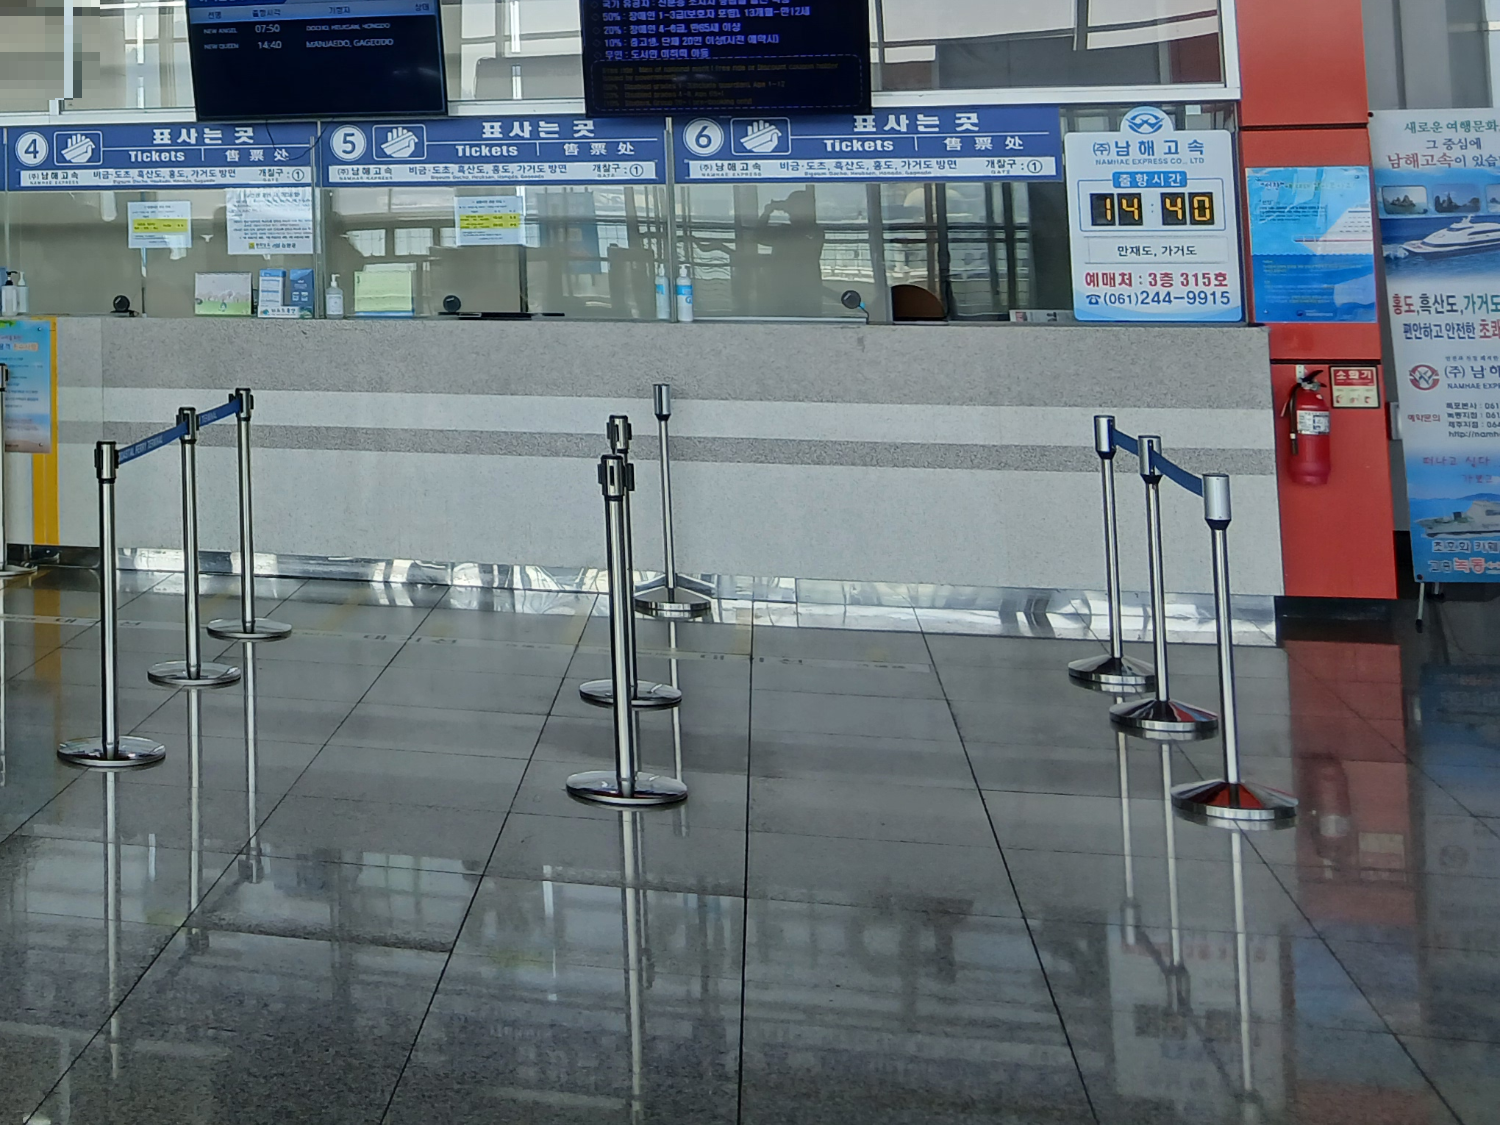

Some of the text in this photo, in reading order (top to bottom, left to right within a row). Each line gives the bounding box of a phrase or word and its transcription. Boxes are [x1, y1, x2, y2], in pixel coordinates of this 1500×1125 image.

[255, 24, 280, 33] 07:50
[258, 41, 281, 49] 14:40
[1405, 120, 1500, 133] 새로운 여행문화
[456, 144, 517, 157] Tickets
[824, 139, 893, 152] Tickets
[1426, 137, 1482, 151] 그 중심에
[129, 151, 184, 163] Tickets
[1387, 152, 1466, 169] 남해고속이
[1119, 173, 1182, 187] 출항시간
[1118, 245, 1197, 257] 만재도, 가거도
[1085, 272, 1228, 288] 예매처 3층 315호
[1104, 291, 1230, 306] (061)244-9915
[1403, 322, 1444, 340] 편안하고
[1445, 322, 1475, 340] 안전한
[1445, 365, 1465, 378] (주)
